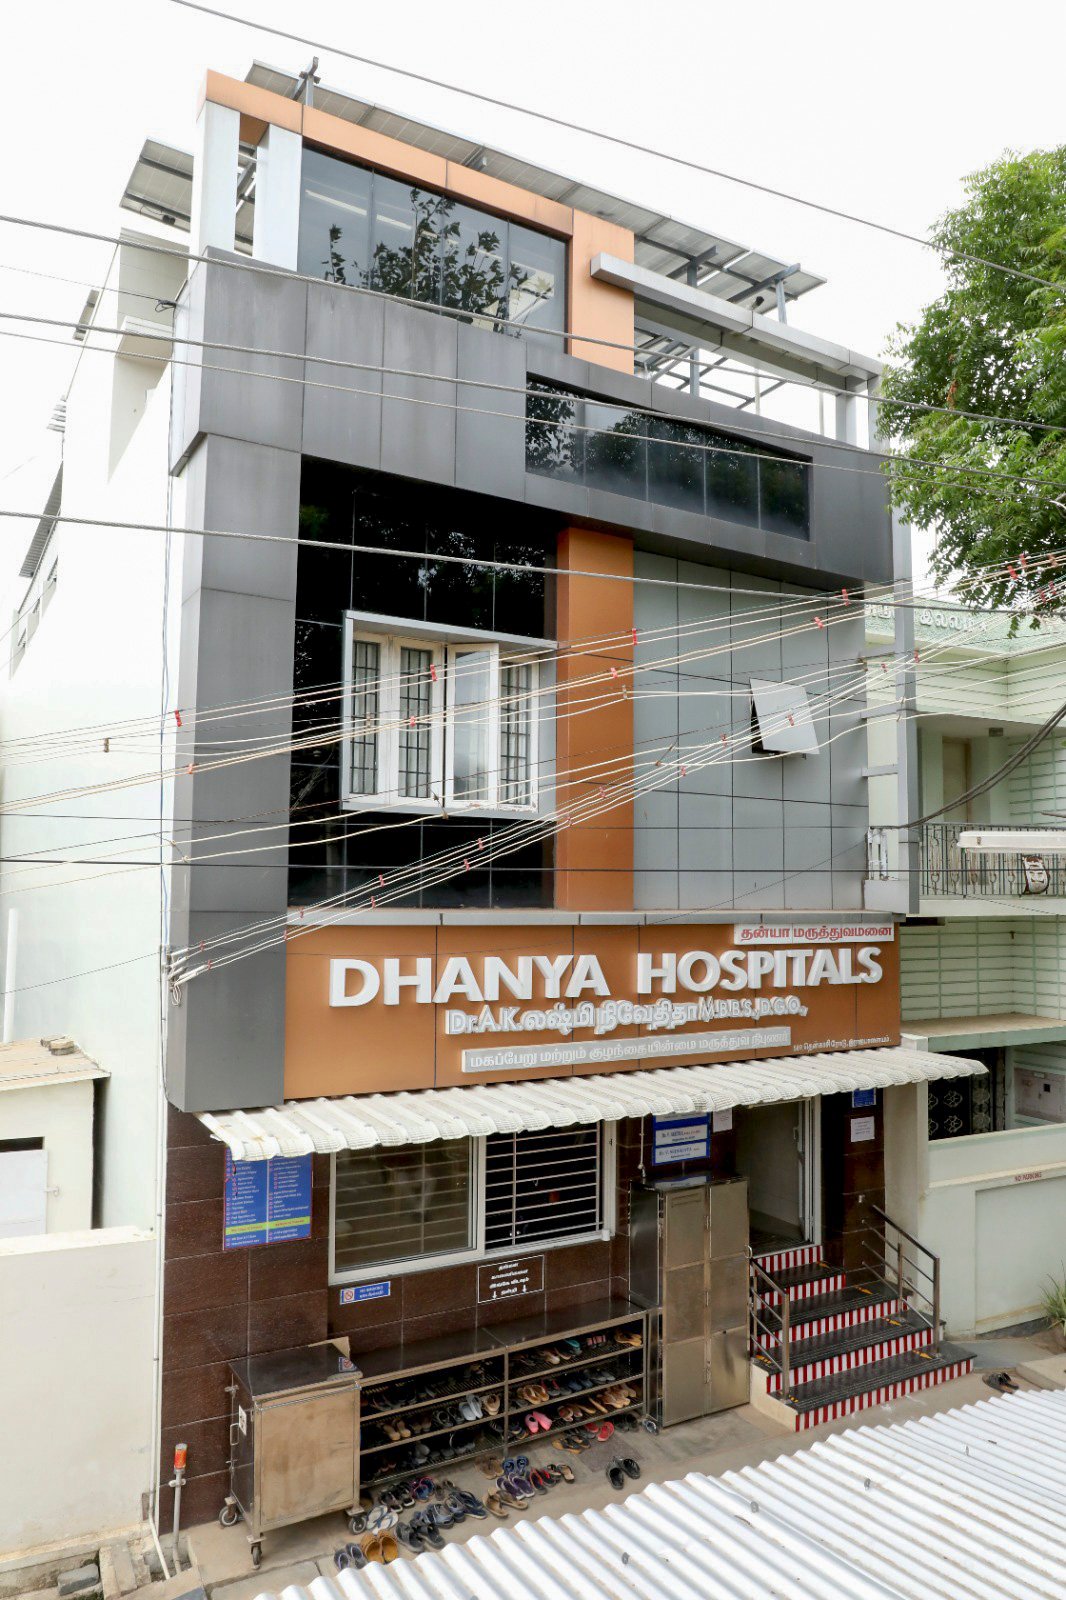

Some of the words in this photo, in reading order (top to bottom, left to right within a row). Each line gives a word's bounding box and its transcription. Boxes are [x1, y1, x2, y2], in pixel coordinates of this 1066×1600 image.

[741, 926, 790, 941] தன்யா
[794, 926, 892, 941] மருத்துவமனை
[329, 954, 610, 1007] DHANYA
[637, 947, 883, 994] HOSPITALS
[470, 1052, 537, 1067] மகப்பேறு
[541, 1047, 586, 1062] மற்றும்
[589, 1040, 697, 1060] குழந்தையின்மை
[700, 1036, 750, 1050] மருத்துவ
